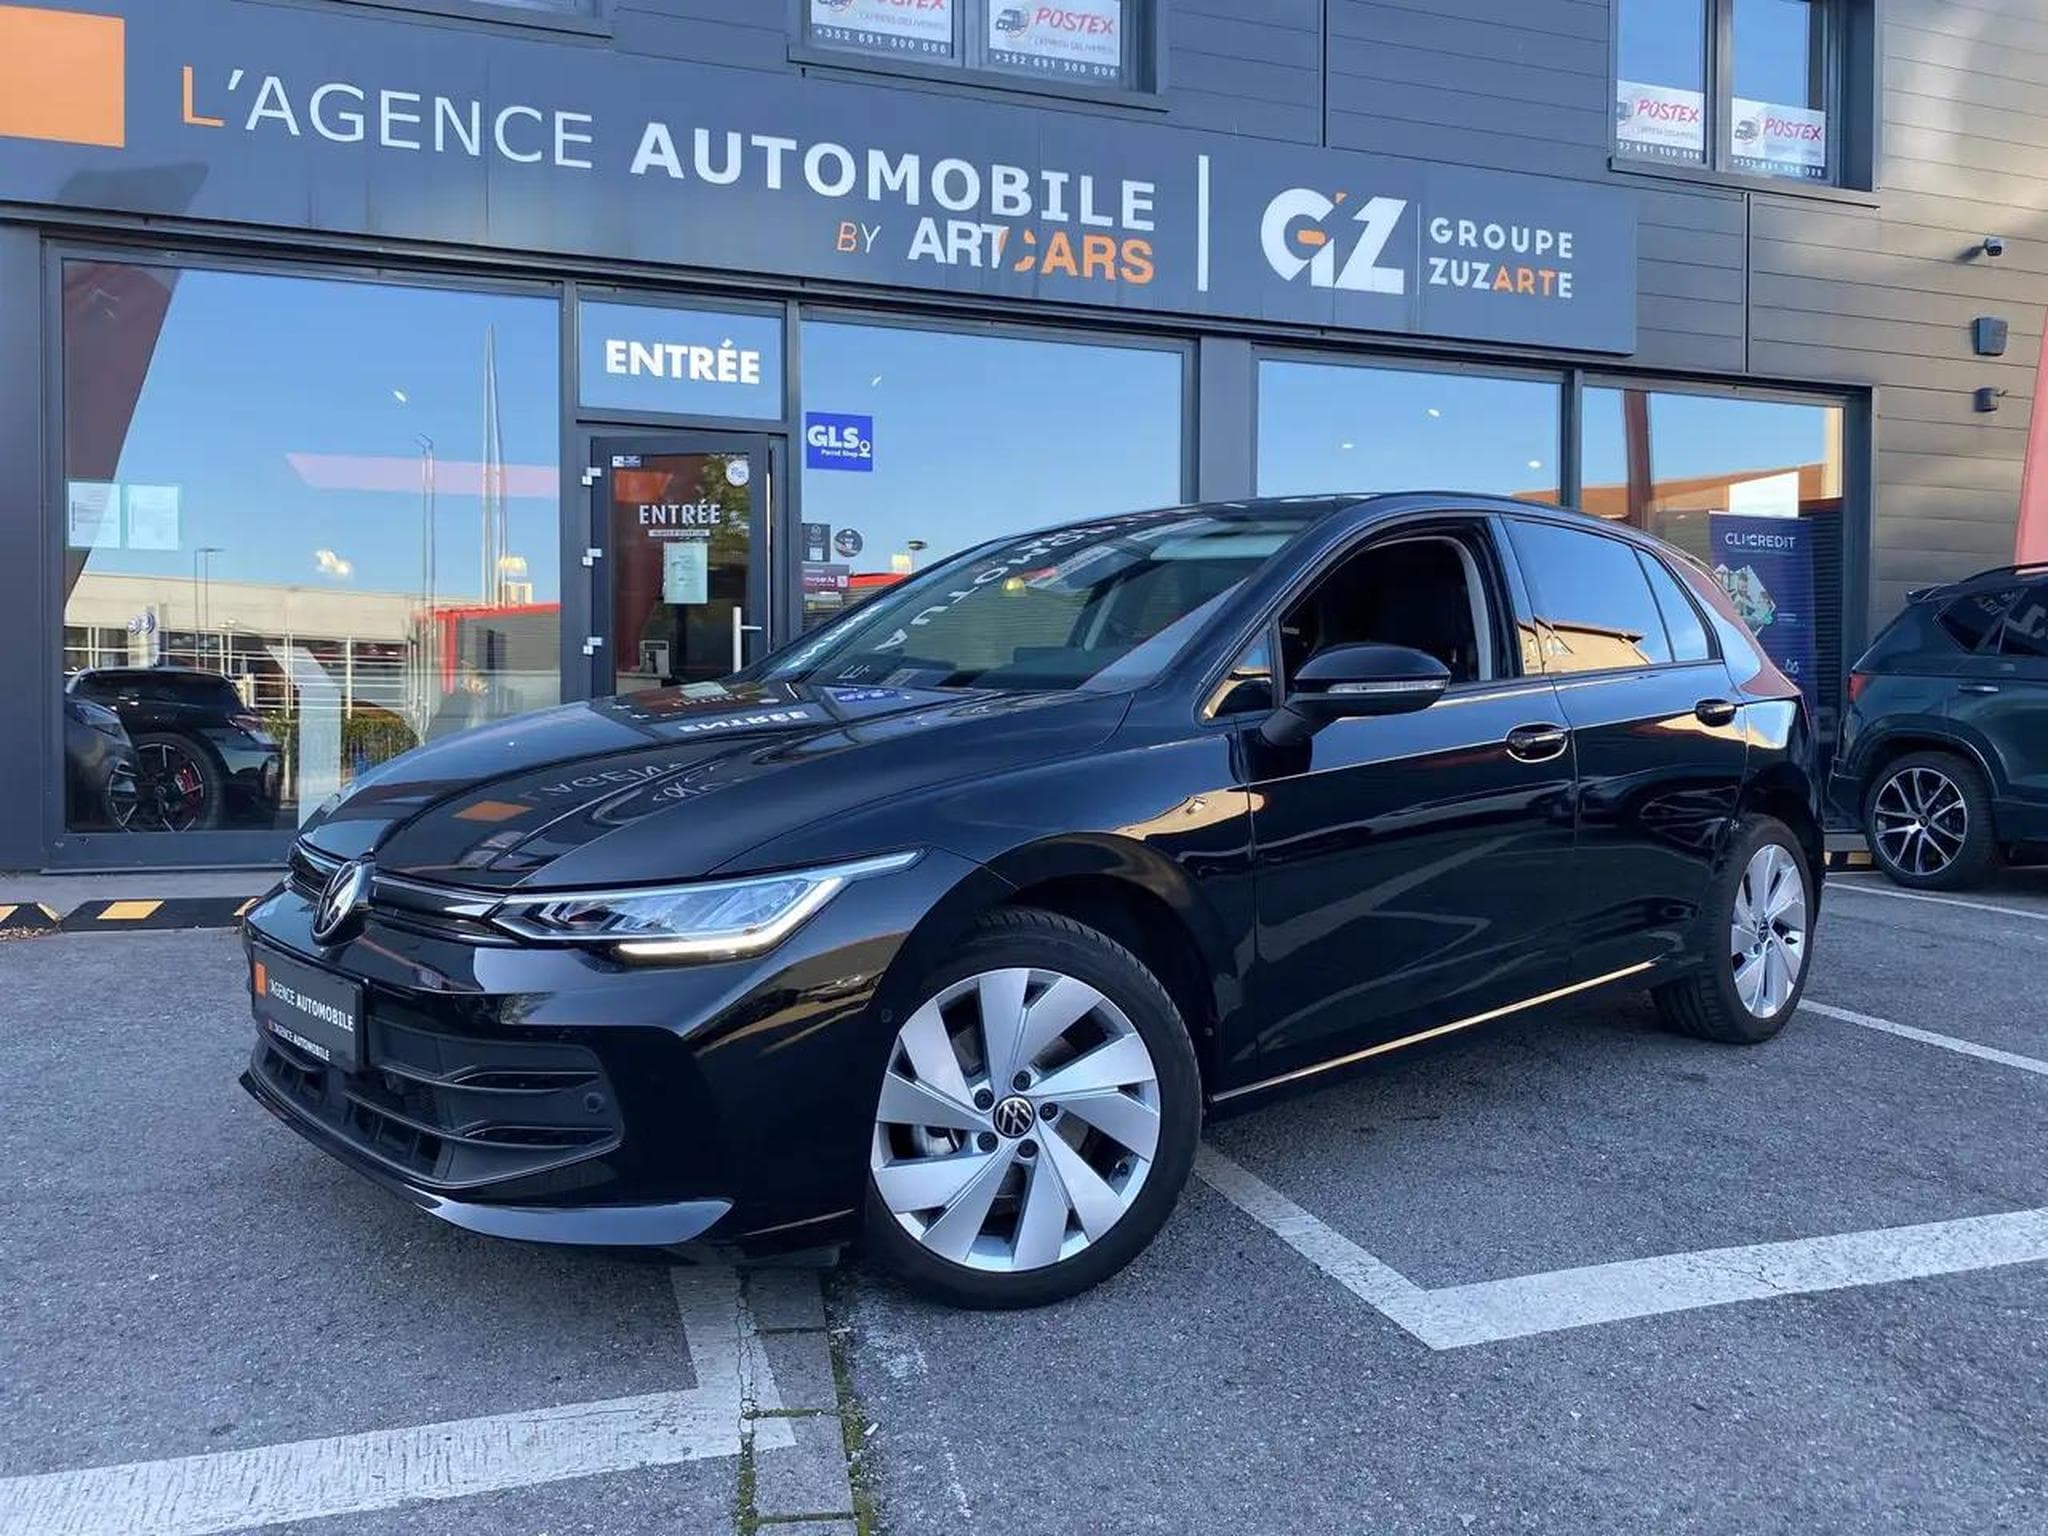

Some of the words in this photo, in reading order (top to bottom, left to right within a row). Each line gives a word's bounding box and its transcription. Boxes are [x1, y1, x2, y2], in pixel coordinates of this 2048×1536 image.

[1035, 7, 1114, 35] POSTEX
[1637, 99, 1699, 123] POSTEX
[1763, 117, 1822, 142] POSTEX
[182, 65, 593, 169] L'AGENCE
[630, 122, 1156, 232] AUTOMOBILE
[836, 221, 881, 254] BY
[1430, 217, 1573, 259] GROUPE
[1429, 257, 1573, 299] ZUZARTE
[605, 338, 760, 385] ENTRÉE
[808, 425, 859, 449] GLS
[639, 498, 721, 524] ENTRÉE
[296, 993, 355, 1033] AUTOMOBILE
